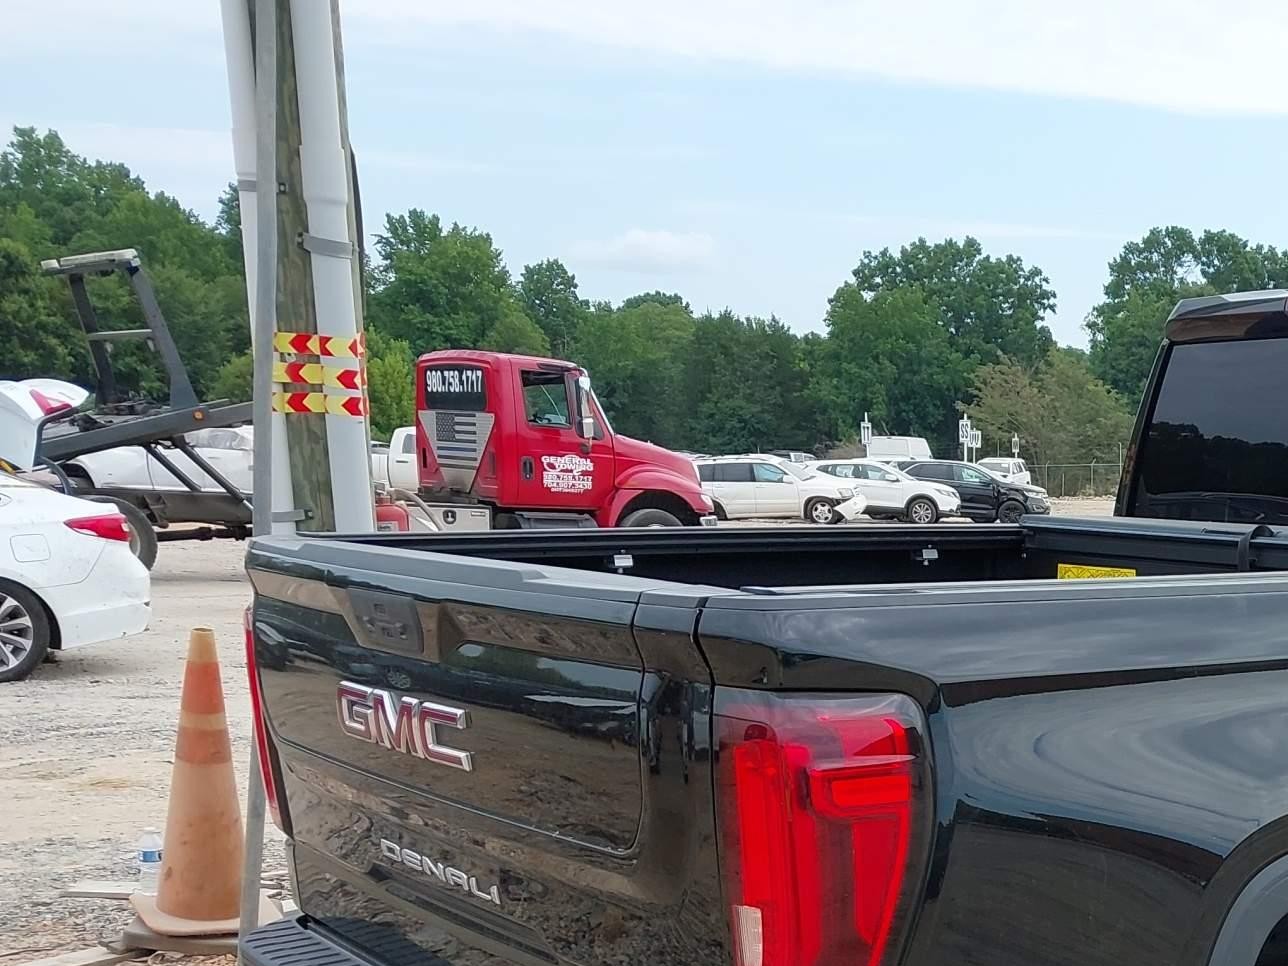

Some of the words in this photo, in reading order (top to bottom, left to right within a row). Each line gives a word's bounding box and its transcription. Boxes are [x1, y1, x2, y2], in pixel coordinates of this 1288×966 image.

[426, 369, 482, 392] 980.758.1717
[960, 422, 970, 439] SS
[541, 456, 591, 465] GENERAL
[555, 462, 594, 471] TOWING
[336, 680, 473, 772] GMC
[380, 838, 501, 905] DENALI
